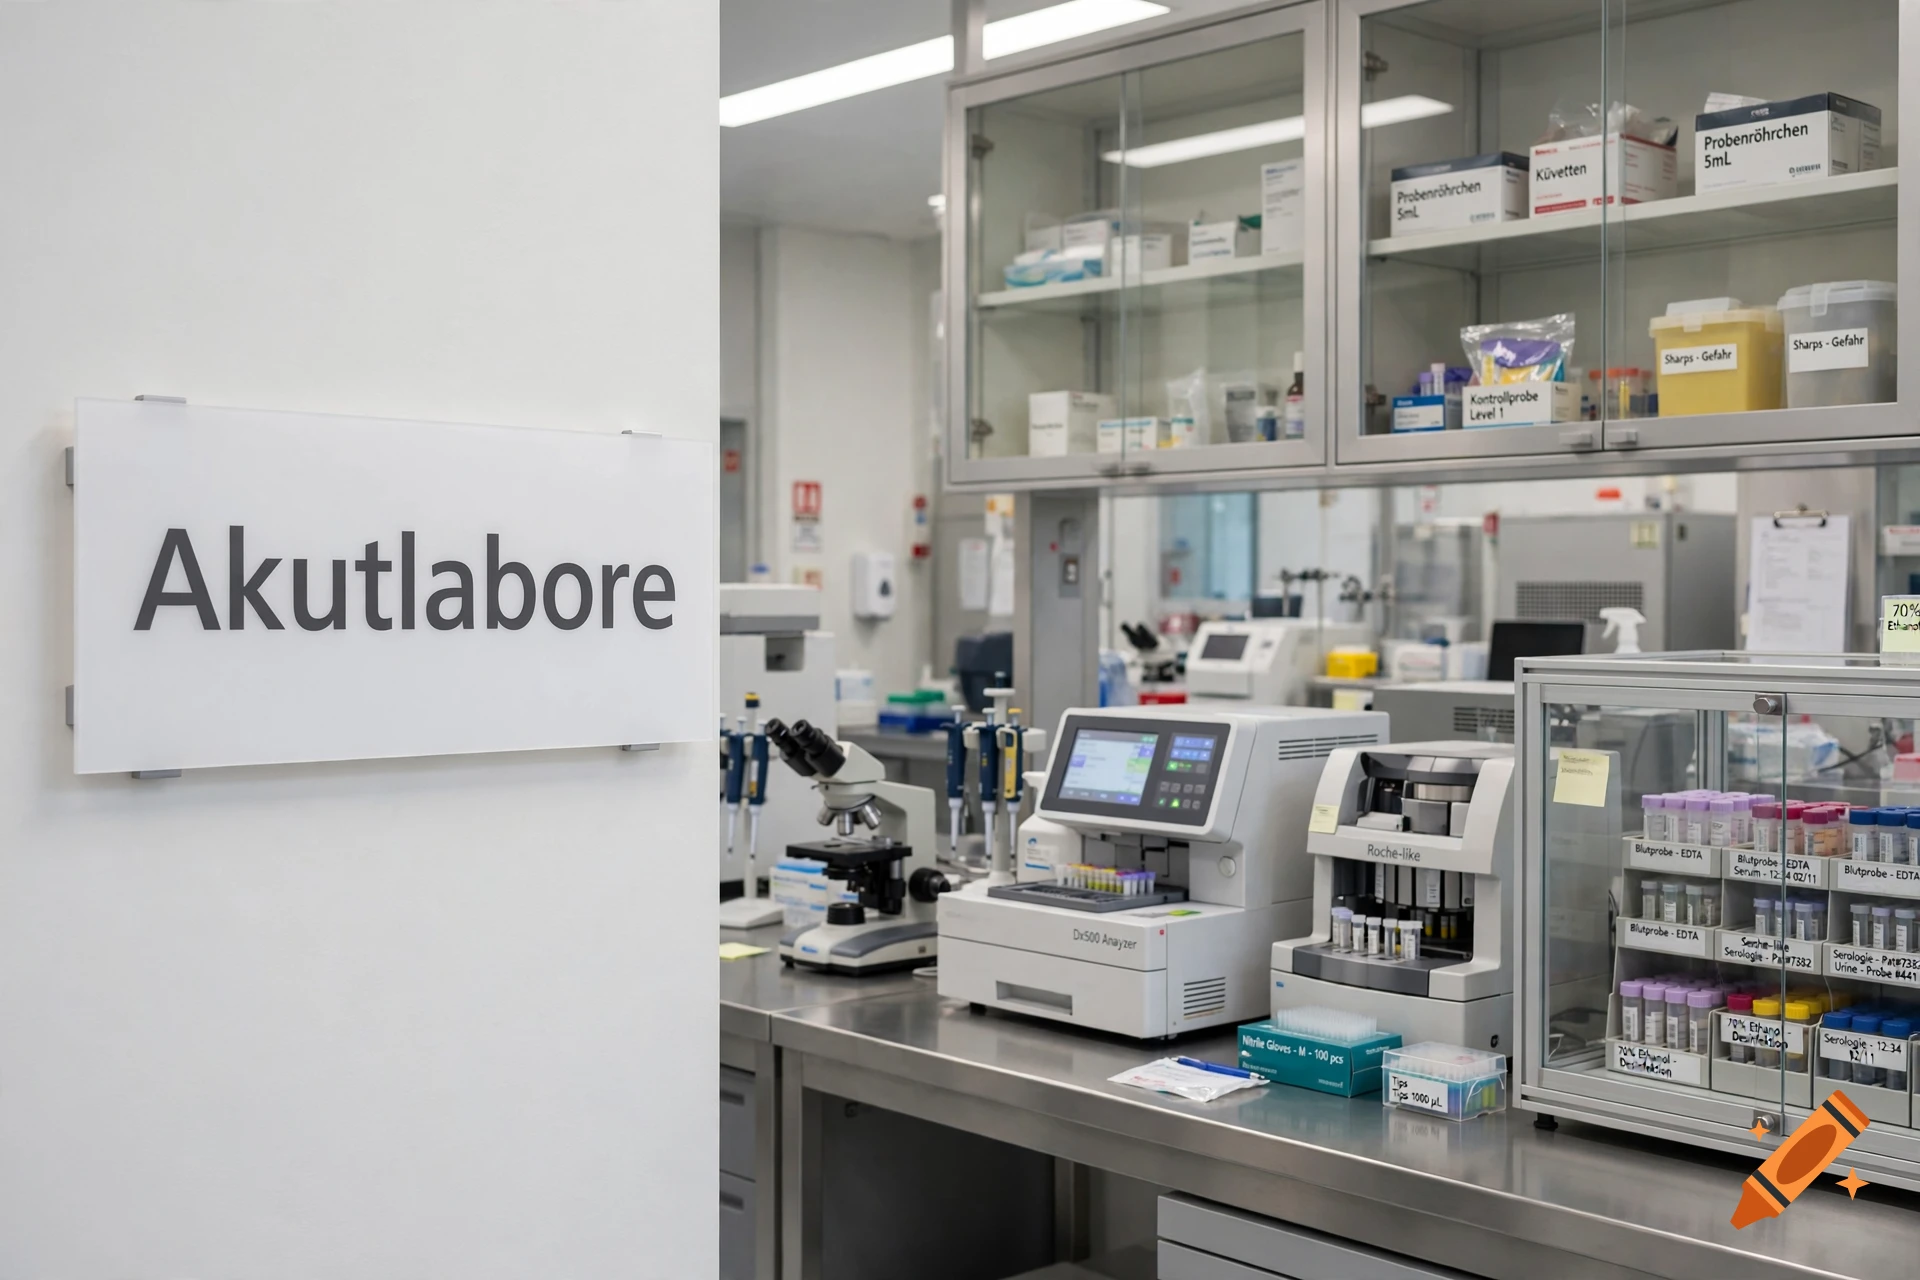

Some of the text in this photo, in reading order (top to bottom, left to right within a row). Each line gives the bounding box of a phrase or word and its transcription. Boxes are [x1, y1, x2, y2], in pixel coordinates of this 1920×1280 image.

[1704, 123, 1808, 150] Probenröhrchen
[1704, 152, 1731, 169] 5mL
[1536, 164, 1587, 181] Küvetten
[1397, 181, 1481, 203] Probenröhrchen
[1397, 206, 1419, 221] 5mL
[1793, 339, 1823, 351] Sharps
[1831, 334, 1864, 347] Gefahr
[1664, 354, 1693, 366] Sharps
[1701, 349, 1732, 361] Gefahr
[1470, 390, 1538, 405] Kontrollprobe
[1470, 407, 1504, 420] Level 1
[133, 525, 676, 632] Akutlabore
[1892, 603, 1920, 617] 70%
[1367, 843, 1421, 862] Roche-like
[1635, 843, 1673, 856] Blutprobe
[1681, 848, 1703, 860] EDTA
[1738, 854, 1778, 867] Blutprobe
[1786, 858, 1810, 870] EDTA
[1793, 872, 1816, 884] 02/11
[1844, 865, 1888, 878] Blutprobe
[1896, 870, 1920, 880] EDTA
[1073, 928, 1100, 944] Dx500
[1630, 923, 1669, 937] Blutprobe
[1676, 929, 1699, 940] EDTA
[1833, 949, 1873, 964] Serologie
[1835, 961, 1857, 974] Urine
[1866, 965, 1892, 979] Probe
[1242, 1035, 1265, 1048] Nitrile
[1266, 1039, 1291, 1054] Gloves
[1299, 1046, 1306, 1057] M
[1315, 1049, 1329, 1061] 100
[1330, 1054, 1344, 1065] pcs
[1824, 1033, 1866, 1050] Serologie
[1392, 1075, 1408, 1089] Tips
[1411, 1092, 1430, 1104] 1000
